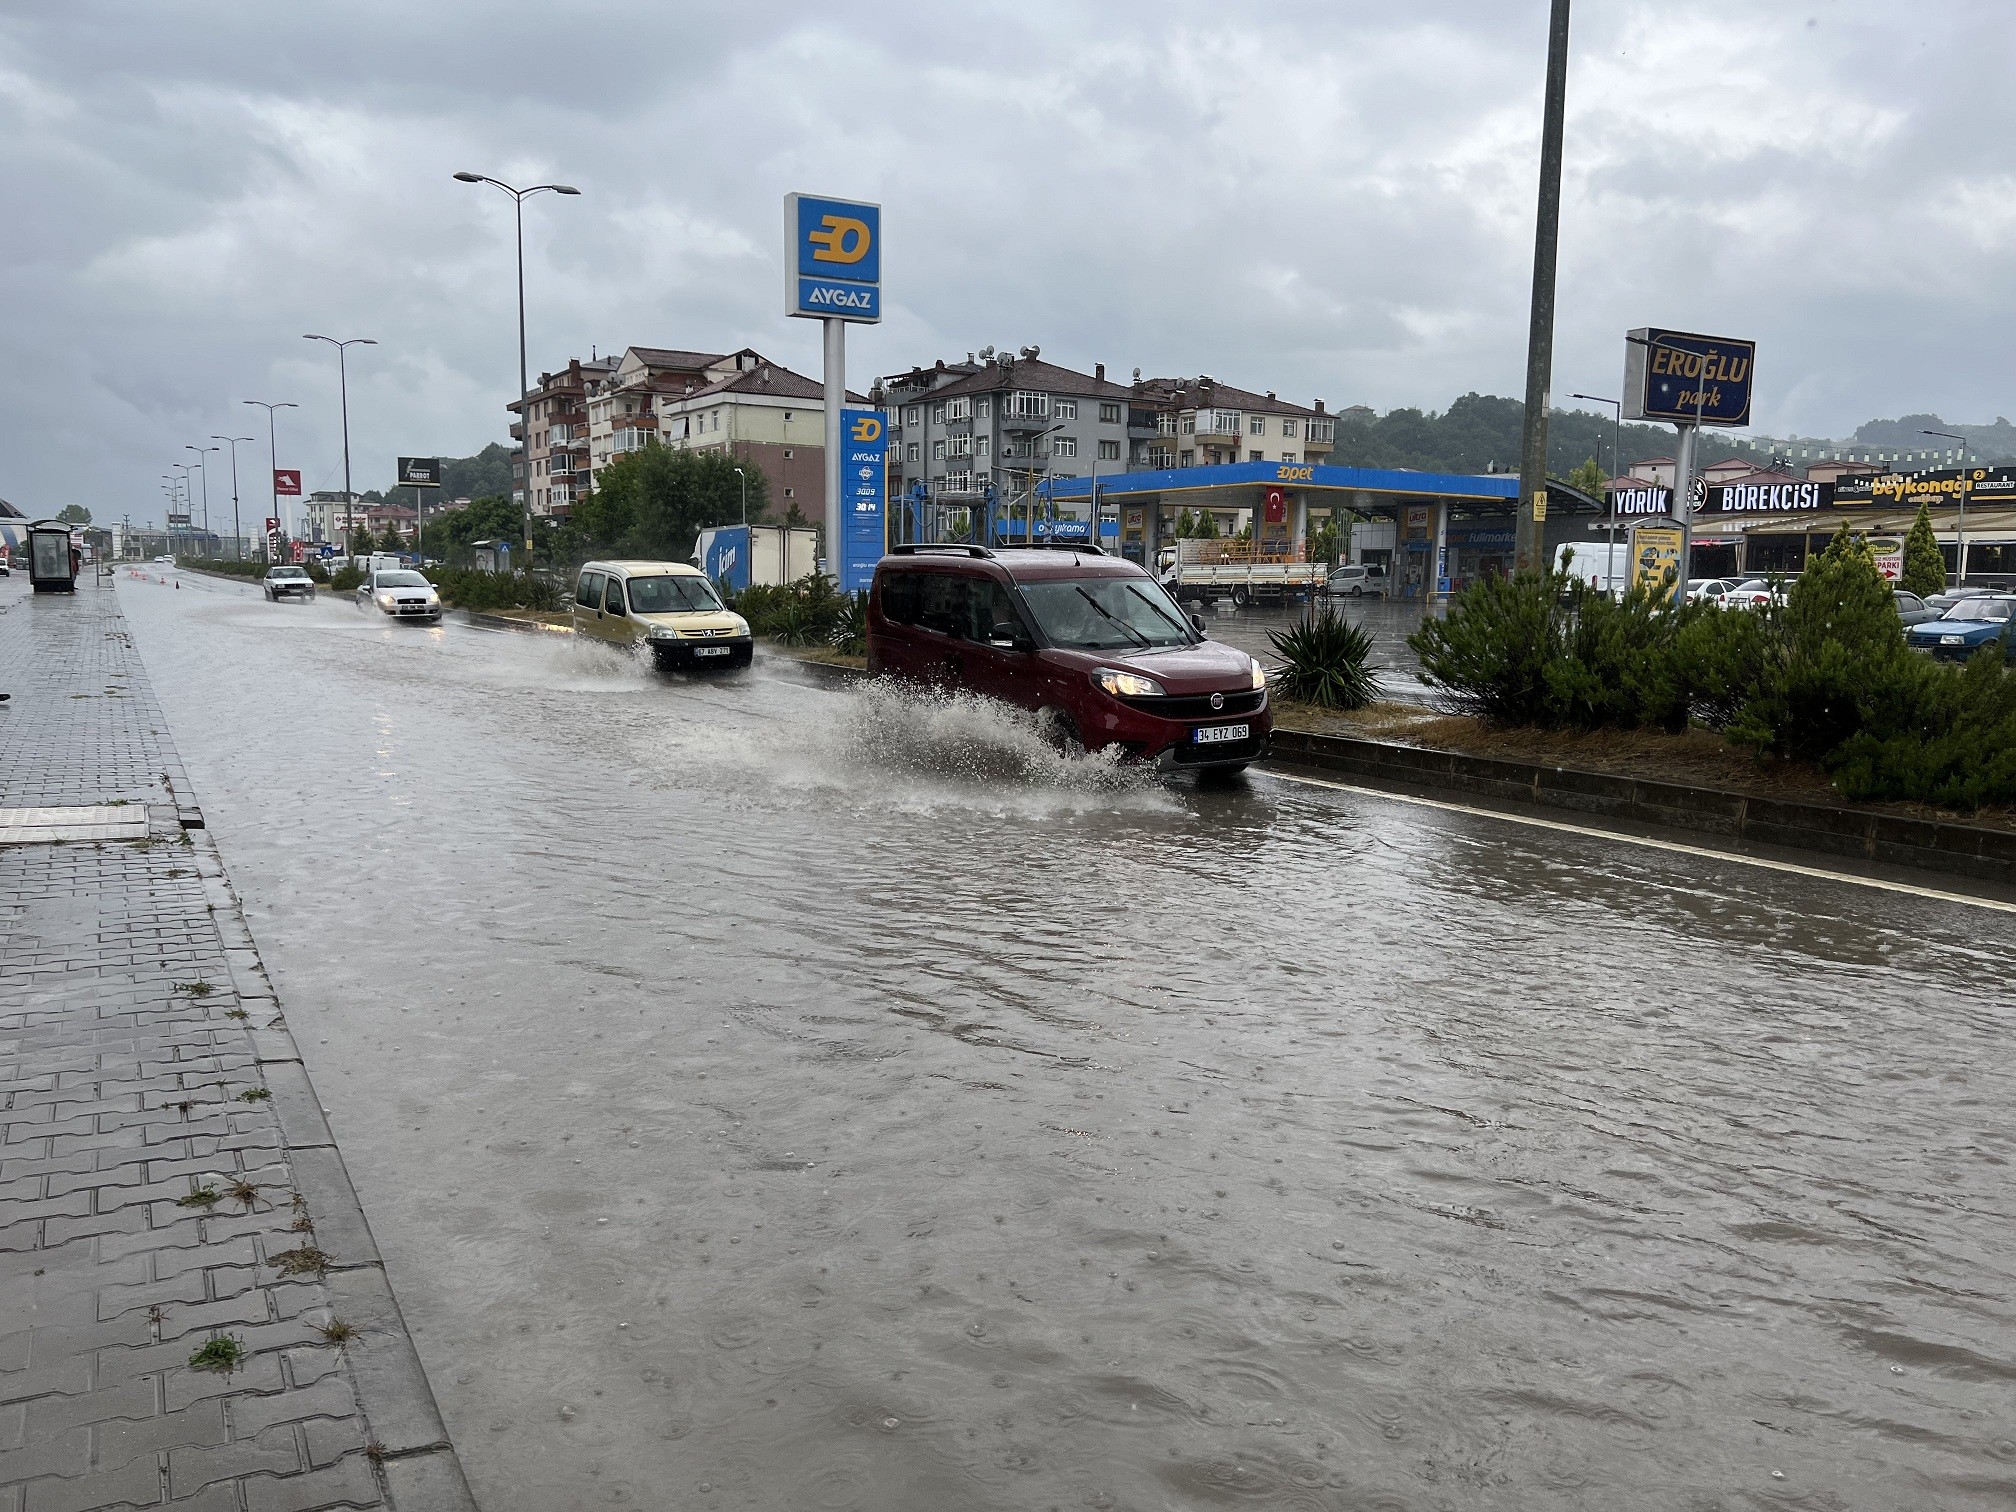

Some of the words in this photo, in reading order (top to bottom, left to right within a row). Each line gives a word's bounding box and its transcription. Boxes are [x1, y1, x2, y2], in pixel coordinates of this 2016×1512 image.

[808, 287, 872, 309] AYGAZ
[1651, 346, 1749, 383] EROĞLU
[1674, 385, 1722, 410] park
[851, 452, 881, 462] AYGAZ
[1277, 465, 1314, 482] opet
[1975, 481, 2015, 490] RESTAURANT
[1615, 485, 1668, 514] YÖRÜK
[1721, 483, 1820, 512] BÖREKÇİSİ
[1469, 532, 1516, 543] Fullmarke
[1199, 730, 1209, 741] 34
[1213, 728, 1229, 740] EYZ
[1232, 726, 1247, 738] 069
